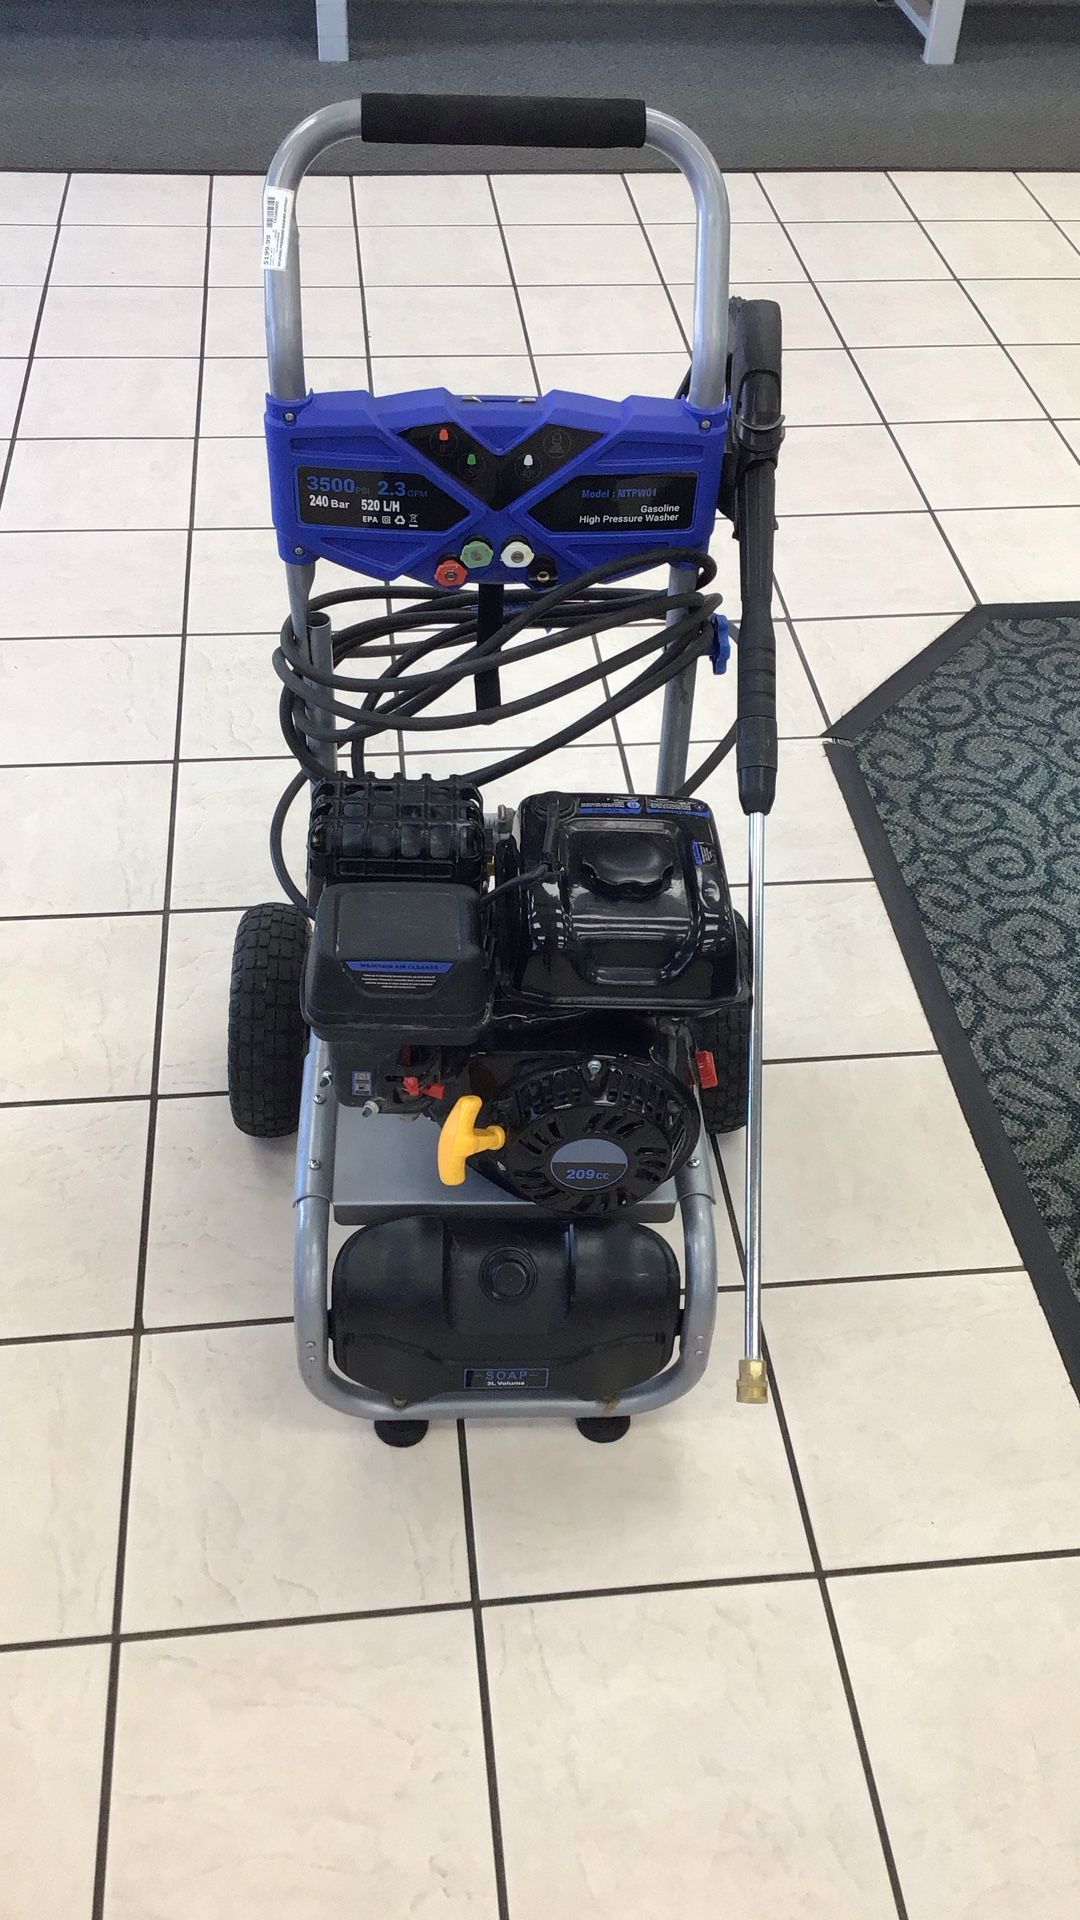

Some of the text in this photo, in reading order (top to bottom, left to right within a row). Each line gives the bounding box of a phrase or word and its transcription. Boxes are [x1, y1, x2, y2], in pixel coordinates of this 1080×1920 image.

[263, 235, 271, 265] $199.99
[307, 475, 355, 493] 3500
[378, 480, 406, 496] 2.3
[581, 489, 609, 498] Model
[617, 488, 657, 497] MTPW01
[309, 494, 400, 512] 240 Bar 520 L/H
[640, 504, 680, 513] Gasoline
[362, 515, 378, 523] EPA
[579, 513, 679, 525] High Pressure Washer
[565, 1169, 610, 1180] 209cc
[486, 1371, 528, 1380] SOAP
